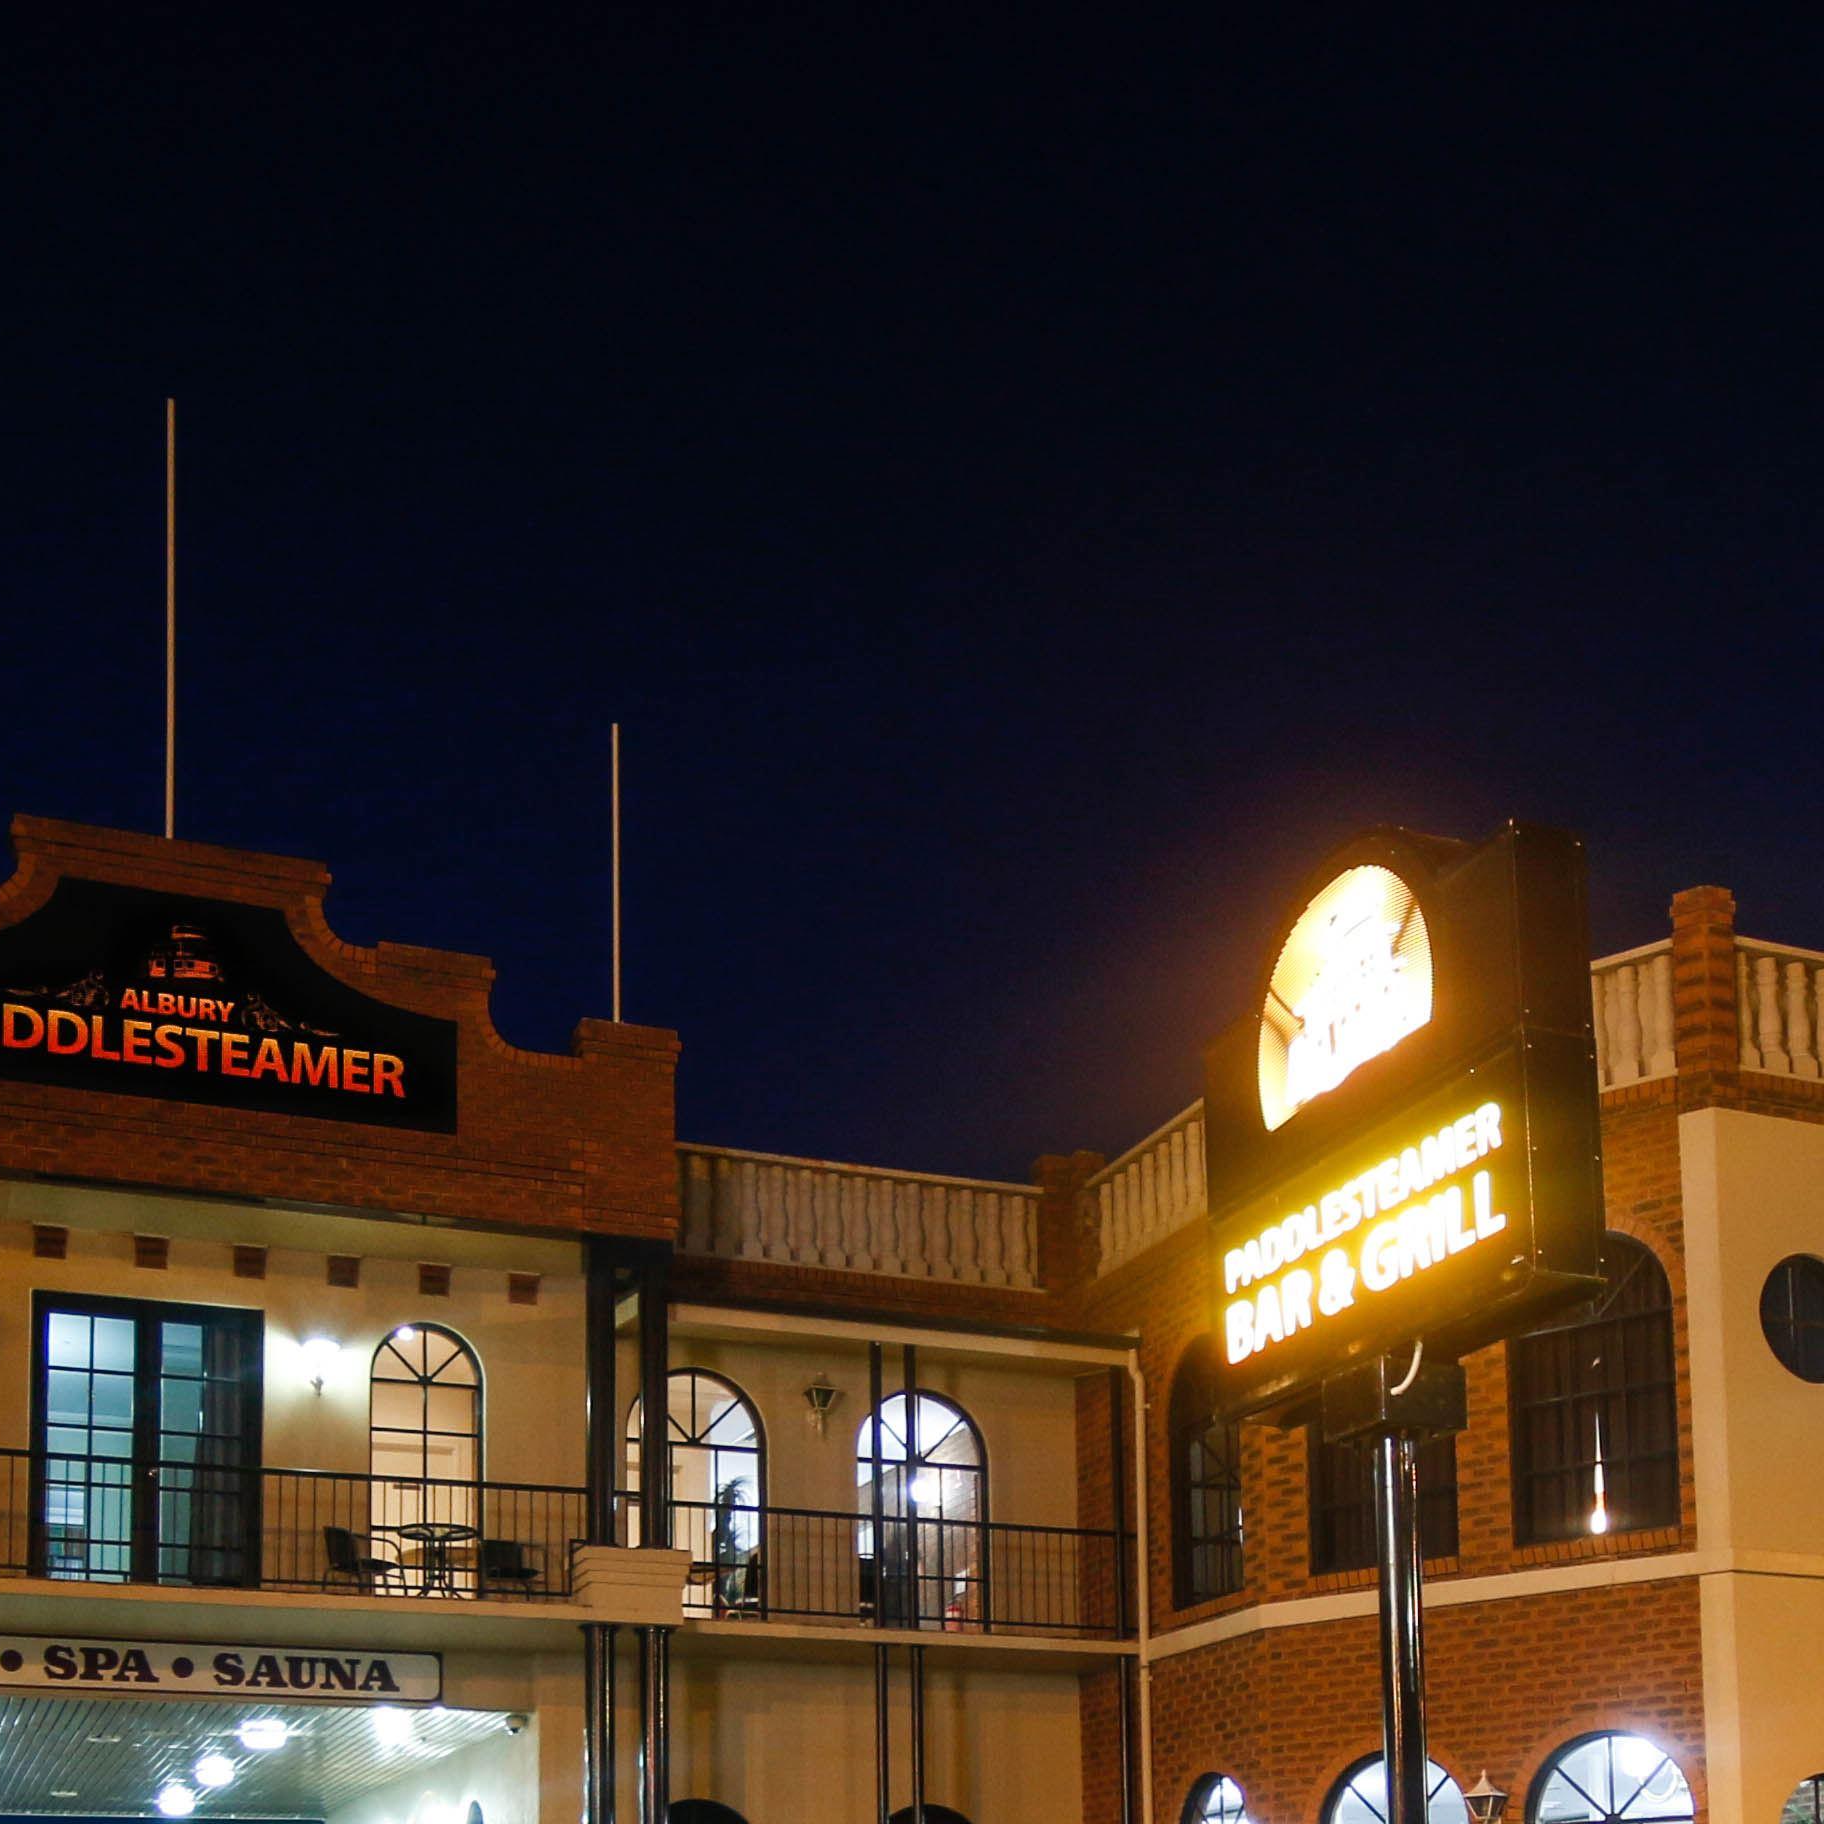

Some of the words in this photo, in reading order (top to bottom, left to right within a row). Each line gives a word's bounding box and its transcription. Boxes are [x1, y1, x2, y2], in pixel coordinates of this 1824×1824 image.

[120, 988, 234, 1023] ALBURY
[1224, 1101, 1503, 1295] PADDLESTEAMER
[1225, 1268, 1313, 1366] BAR
[1318, 1248, 1356, 1317] &
[1359, 1169, 1507, 1292] GRILL
[43, 1645, 160, 1684] SPA
[213, 1651, 401, 1693] SAUNA
